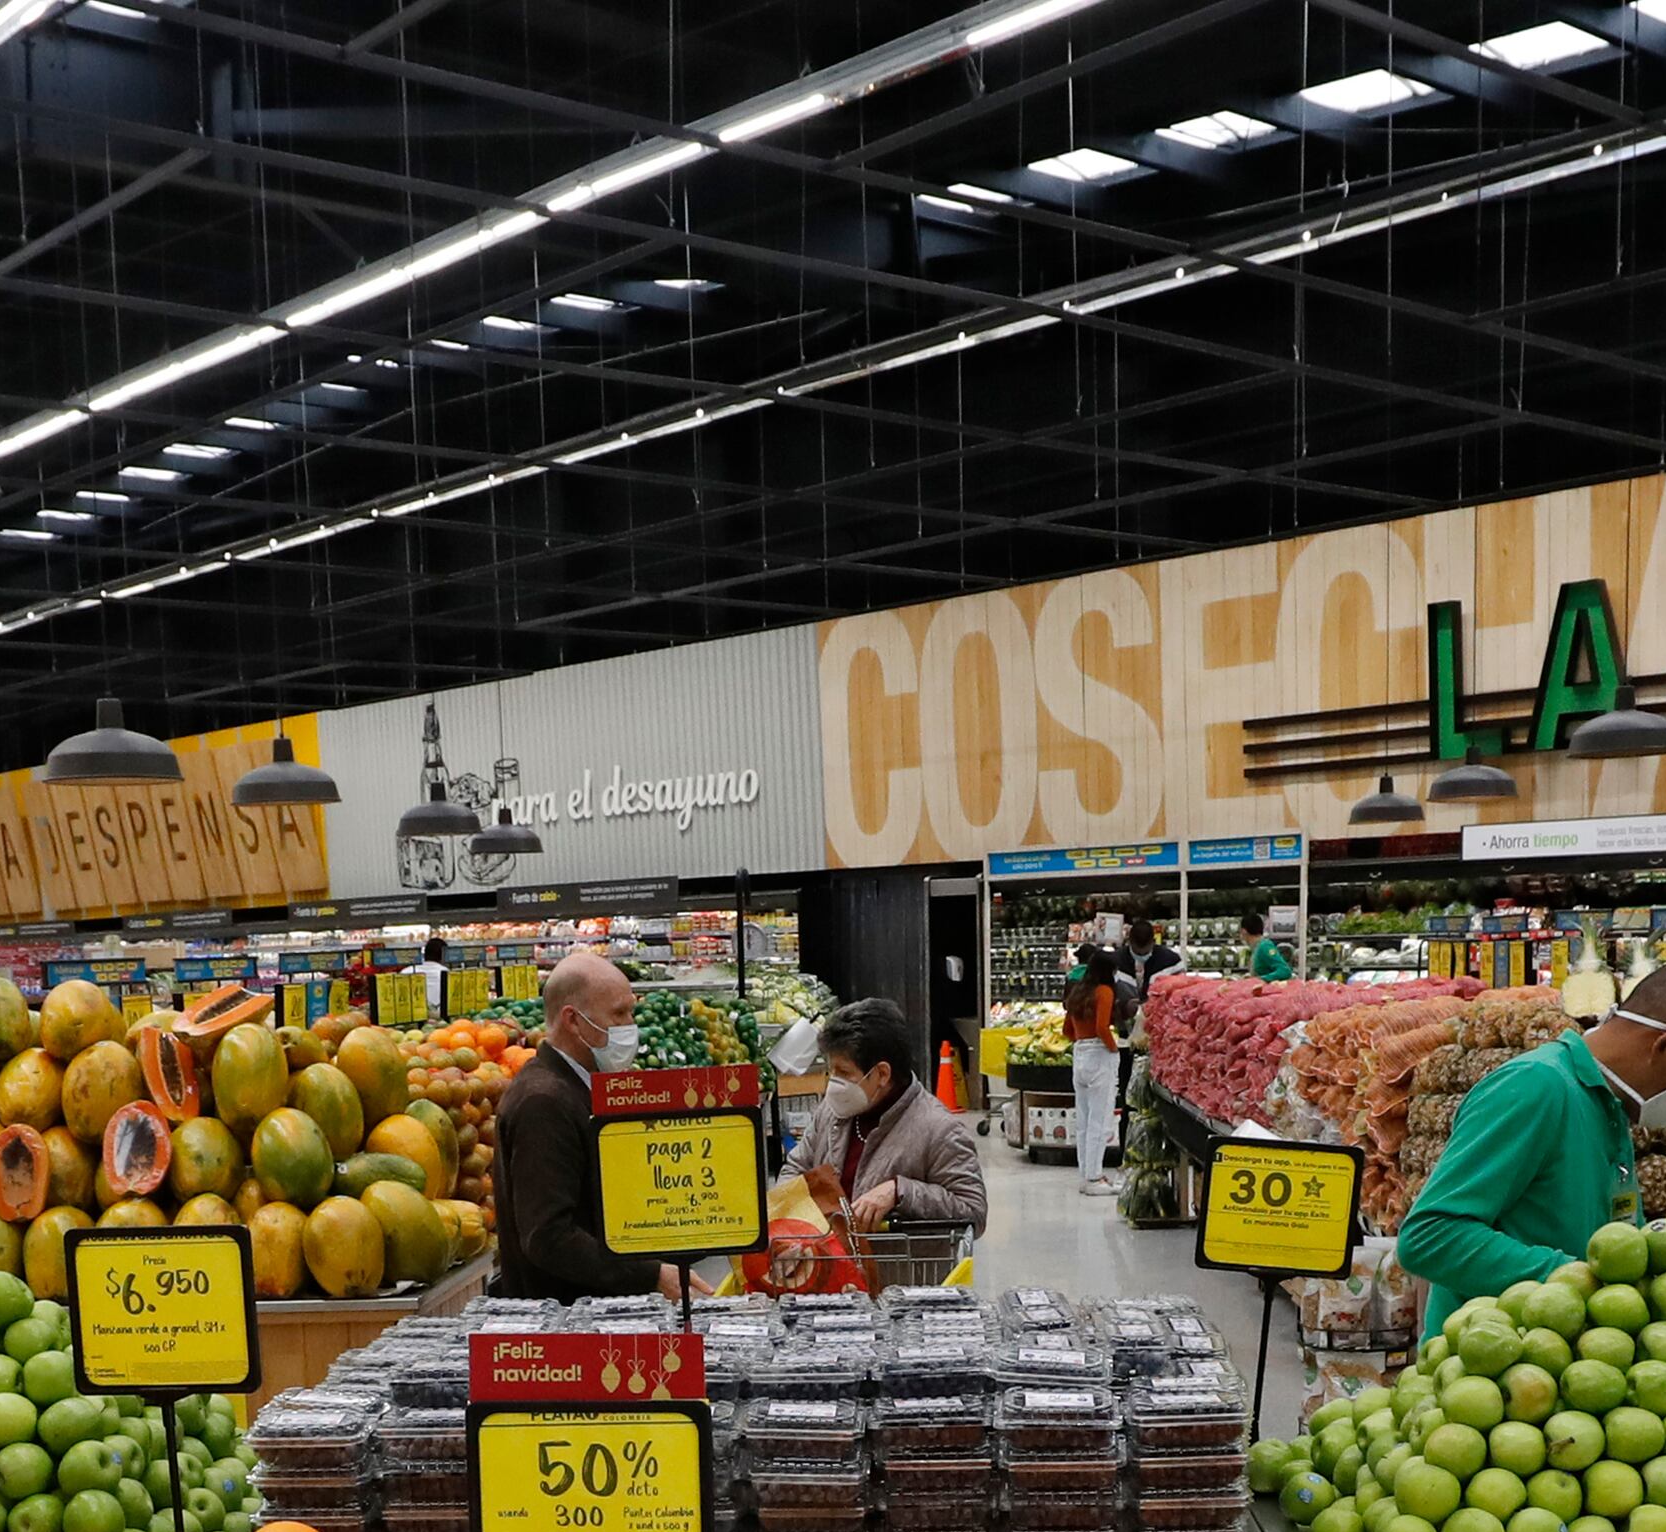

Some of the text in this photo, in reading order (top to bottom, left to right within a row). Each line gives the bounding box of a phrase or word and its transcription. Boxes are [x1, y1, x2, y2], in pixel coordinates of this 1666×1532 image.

[1427, 578, 1633, 760] LA
[568, 768, 592, 822] el
[603, 764, 761, 832] desayuno
[35, 791, 306, 876] DESPENSA
[1490, 830, 1579, 851] Ahorra tiempo
[605, 1077, 643, 1094] ¡Feliz
[606, 1091, 671, 1107] navidad!
[646, 1137, 712, 1164] paga 2
[1223, 1154, 1263, 1165] Descarga
[654, 1165, 716, 1190] lleva 3
[1229, 1169, 1292, 1207] 30
[106, 1267, 210, 1316] $6.950
[92, 1323, 133, 1336] Manzana
[135, 1323, 161, 1335] verde
[492, 1341, 545, 1363] ¡Feliz
[492, 1364, 583, 1383] navidad!
[538, 1440, 659, 1497] 50%
[626, 1481, 659, 1497] dcto
[497, 1504, 695, 1528] usando 300 Puntos Colombia
